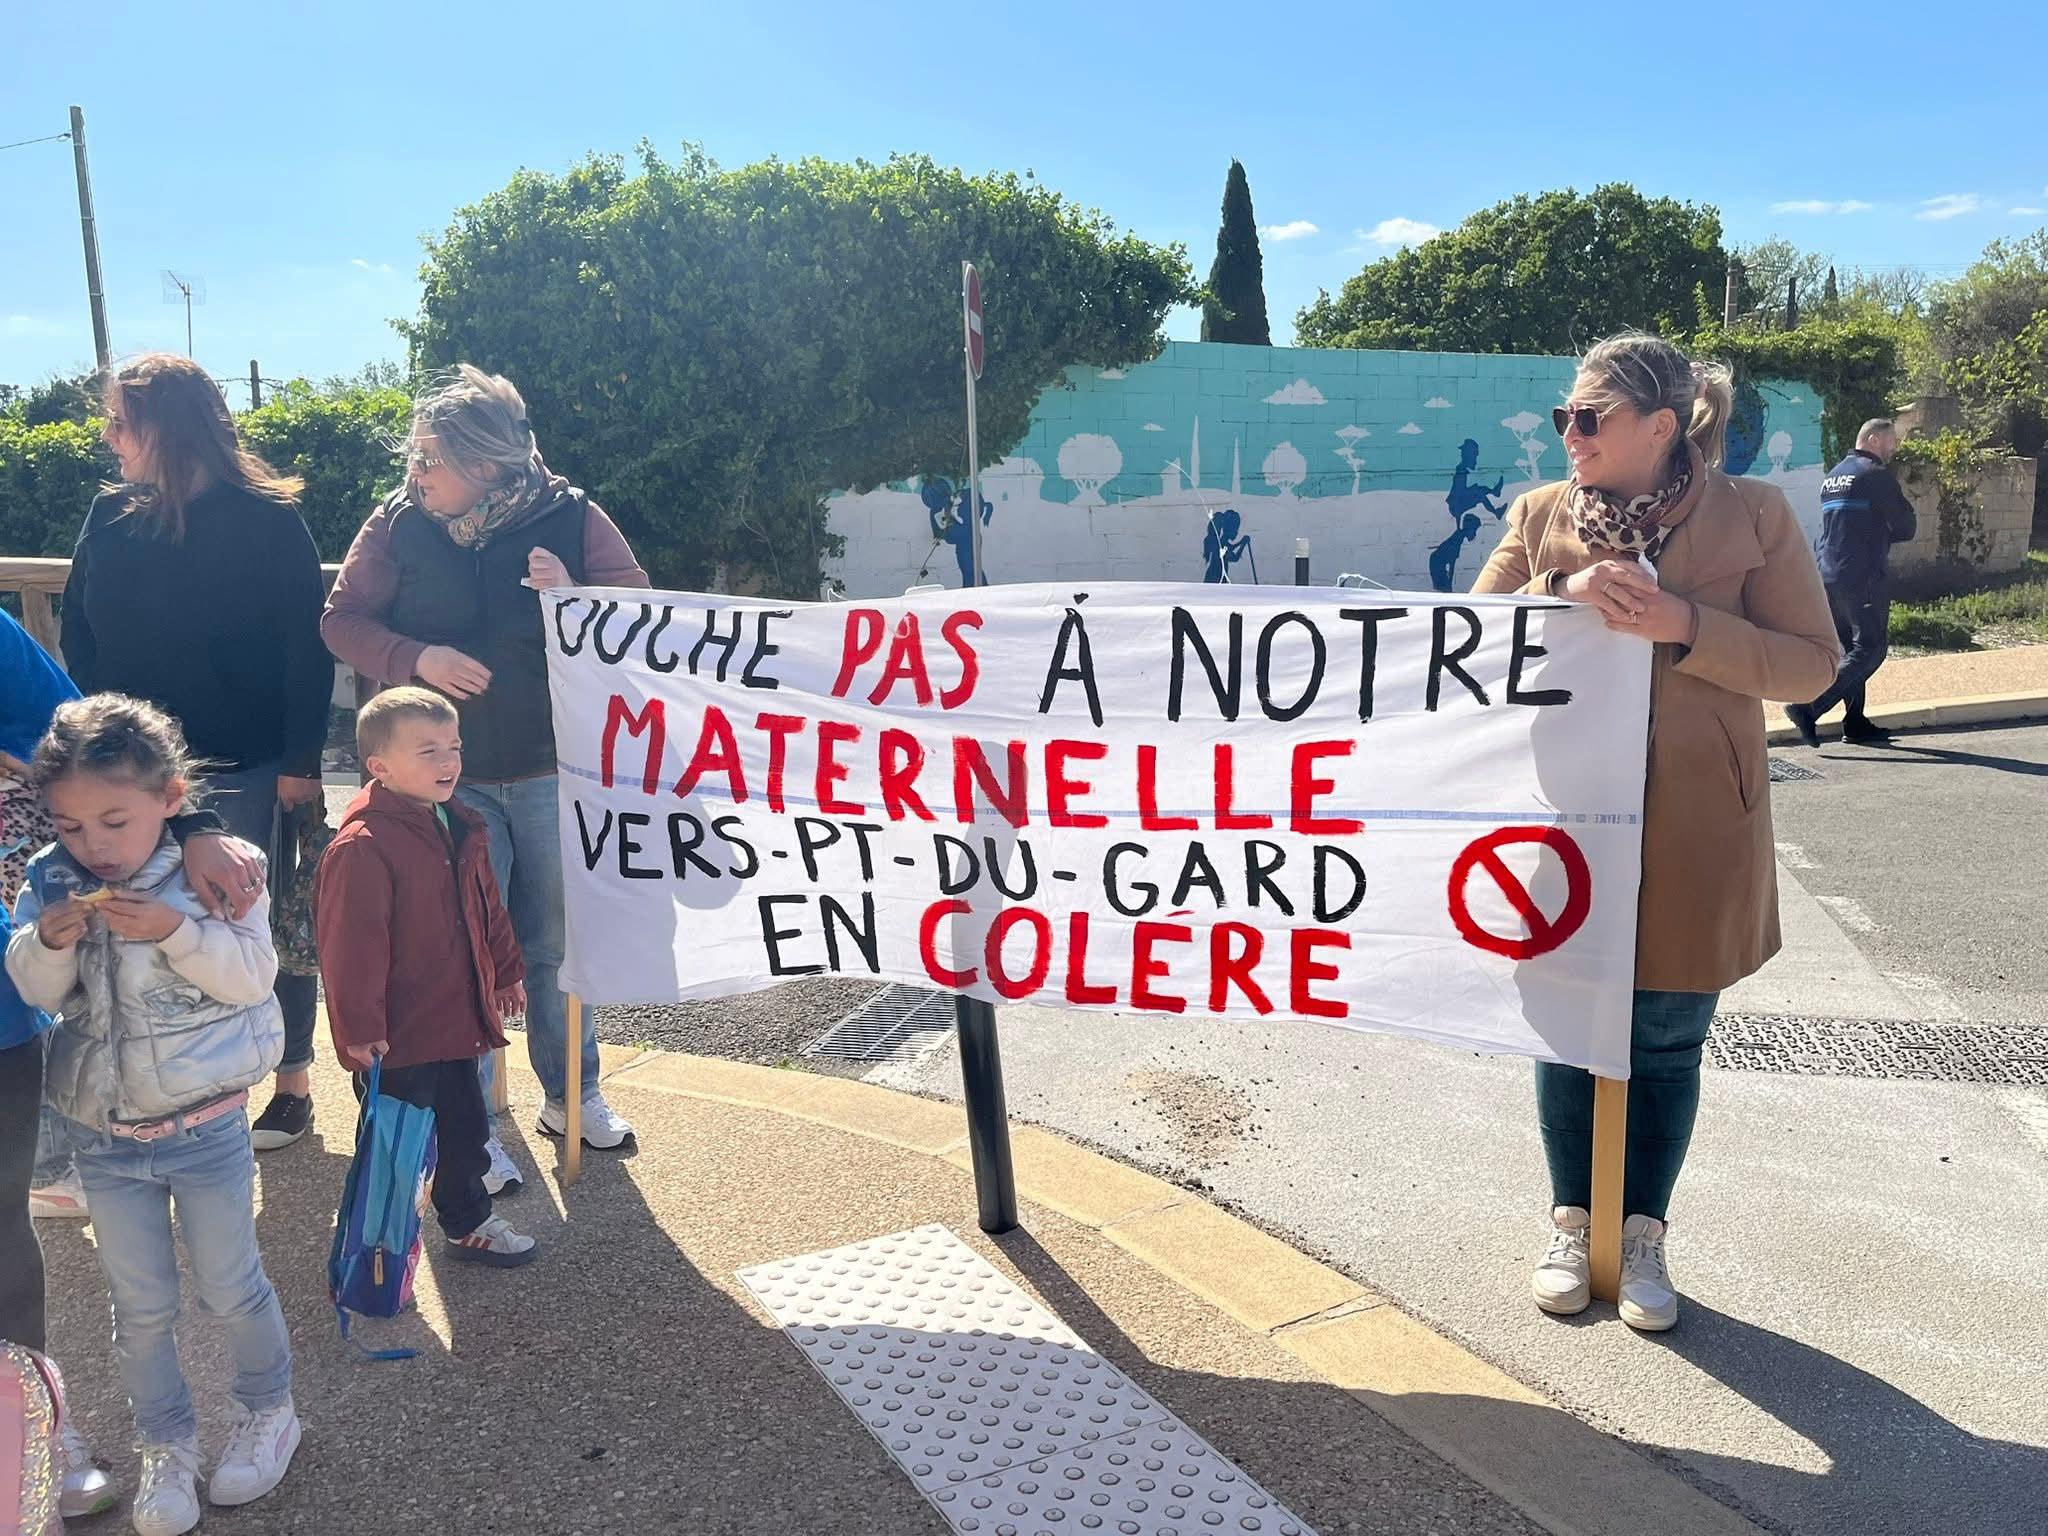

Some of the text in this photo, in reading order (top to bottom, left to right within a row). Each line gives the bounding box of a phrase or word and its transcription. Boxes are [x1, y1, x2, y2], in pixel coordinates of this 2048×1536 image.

[1821, 474, 1856, 491] POLICE
[555, 597, 793, 690] OUCHE
[831, 608, 984, 710] PAS
[1167, 604, 1574, 723] NOTRE
[602, 694, 1365, 836] MATERNELLE
[758, 891, 881, 976] EN
